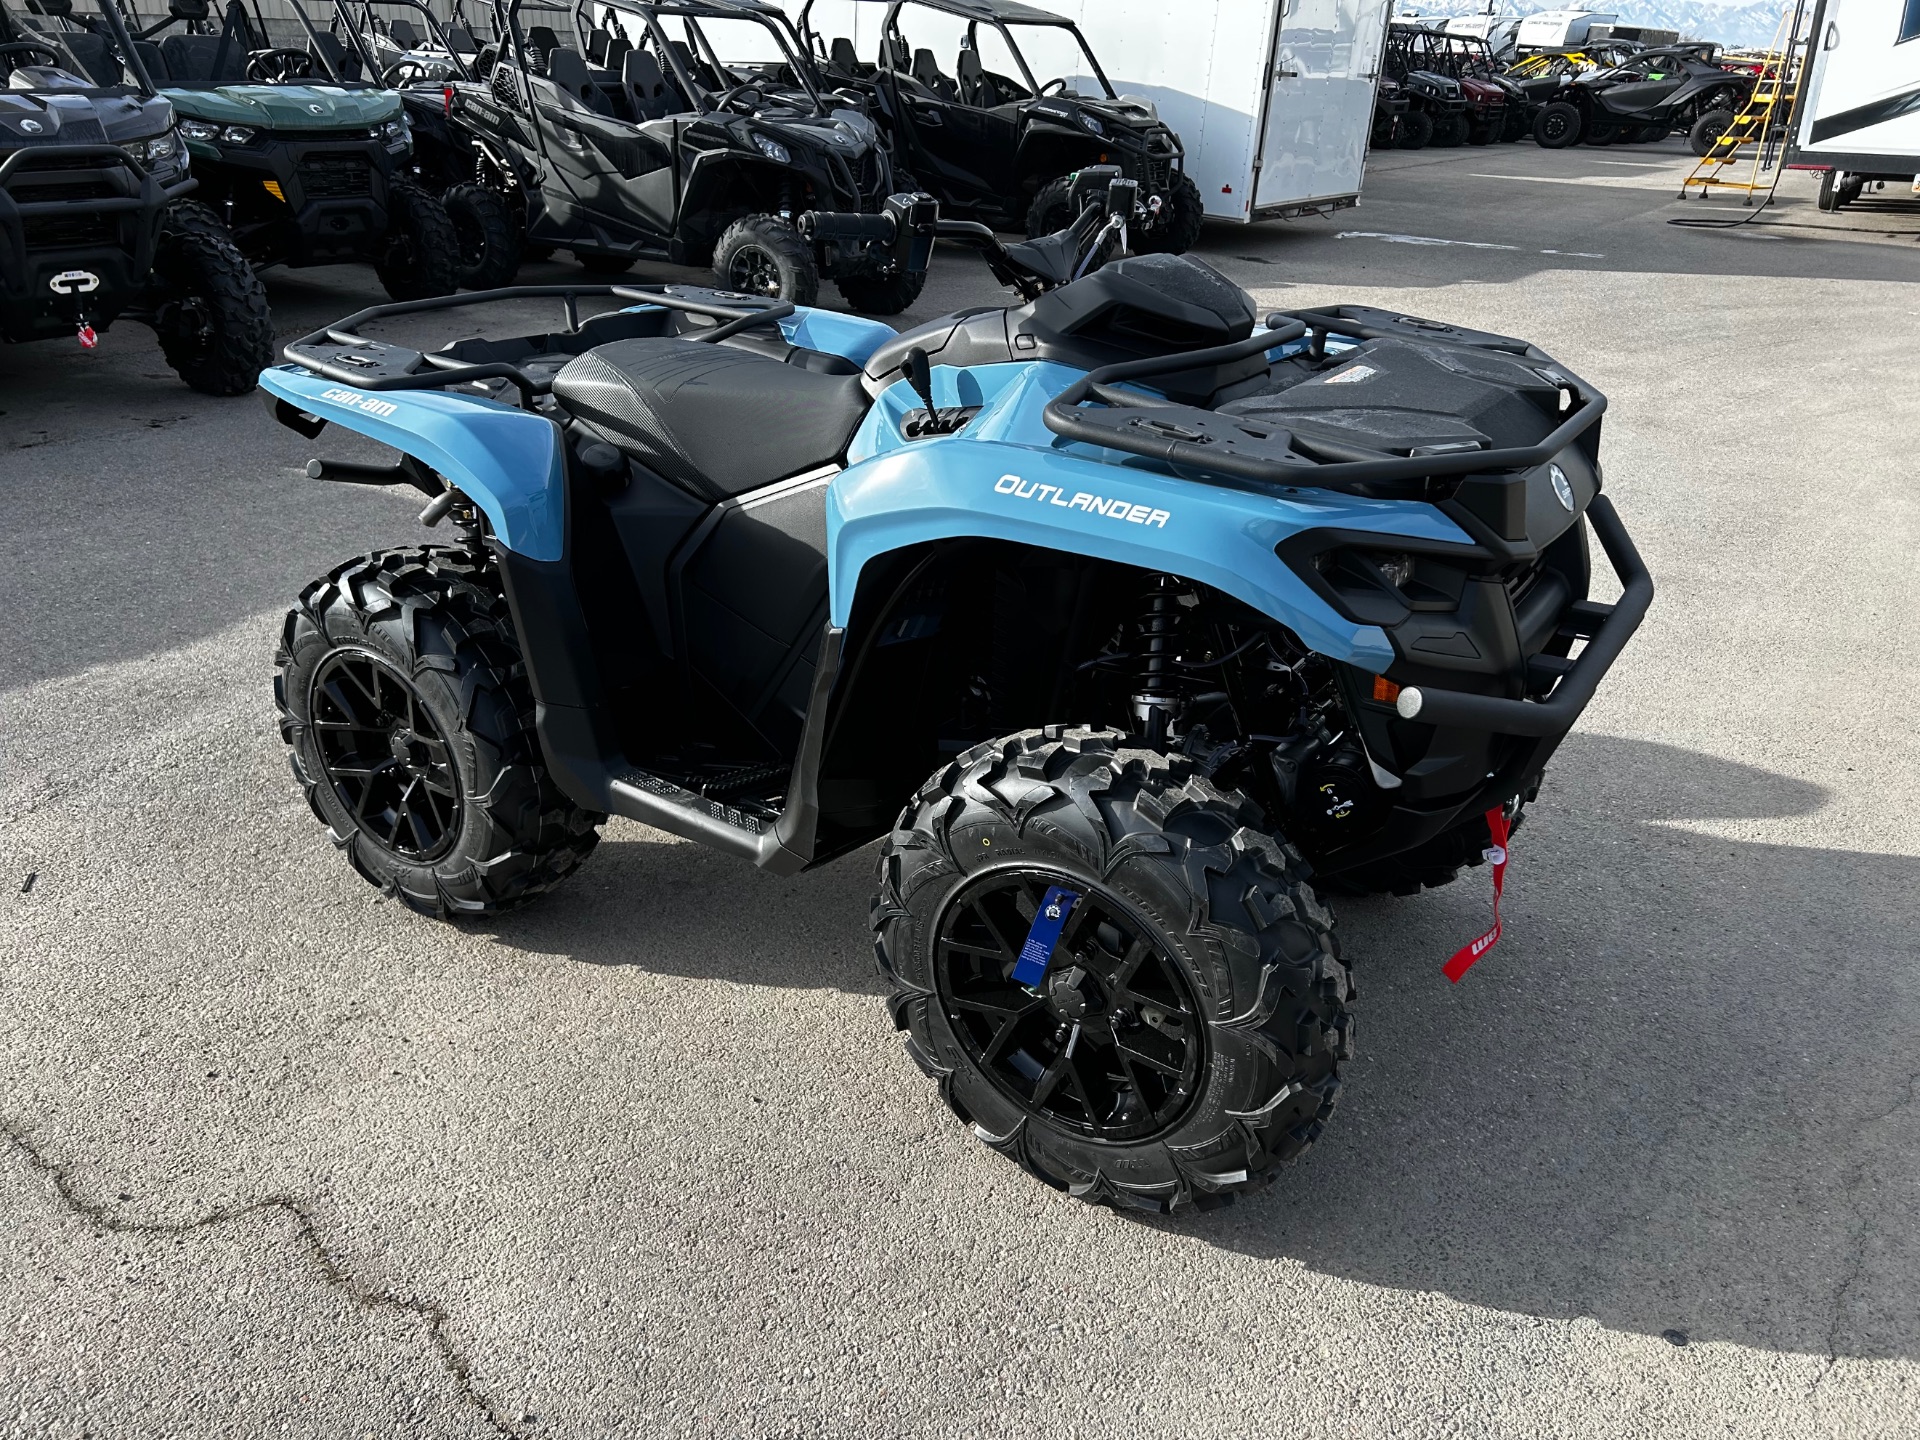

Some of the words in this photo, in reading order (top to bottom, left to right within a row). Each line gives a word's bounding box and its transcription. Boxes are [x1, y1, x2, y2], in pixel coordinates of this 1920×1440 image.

[464, 98, 501, 126] can-am
[320, 387, 399, 418] can-am
[993, 473, 1171, 529] OUTLANDER
